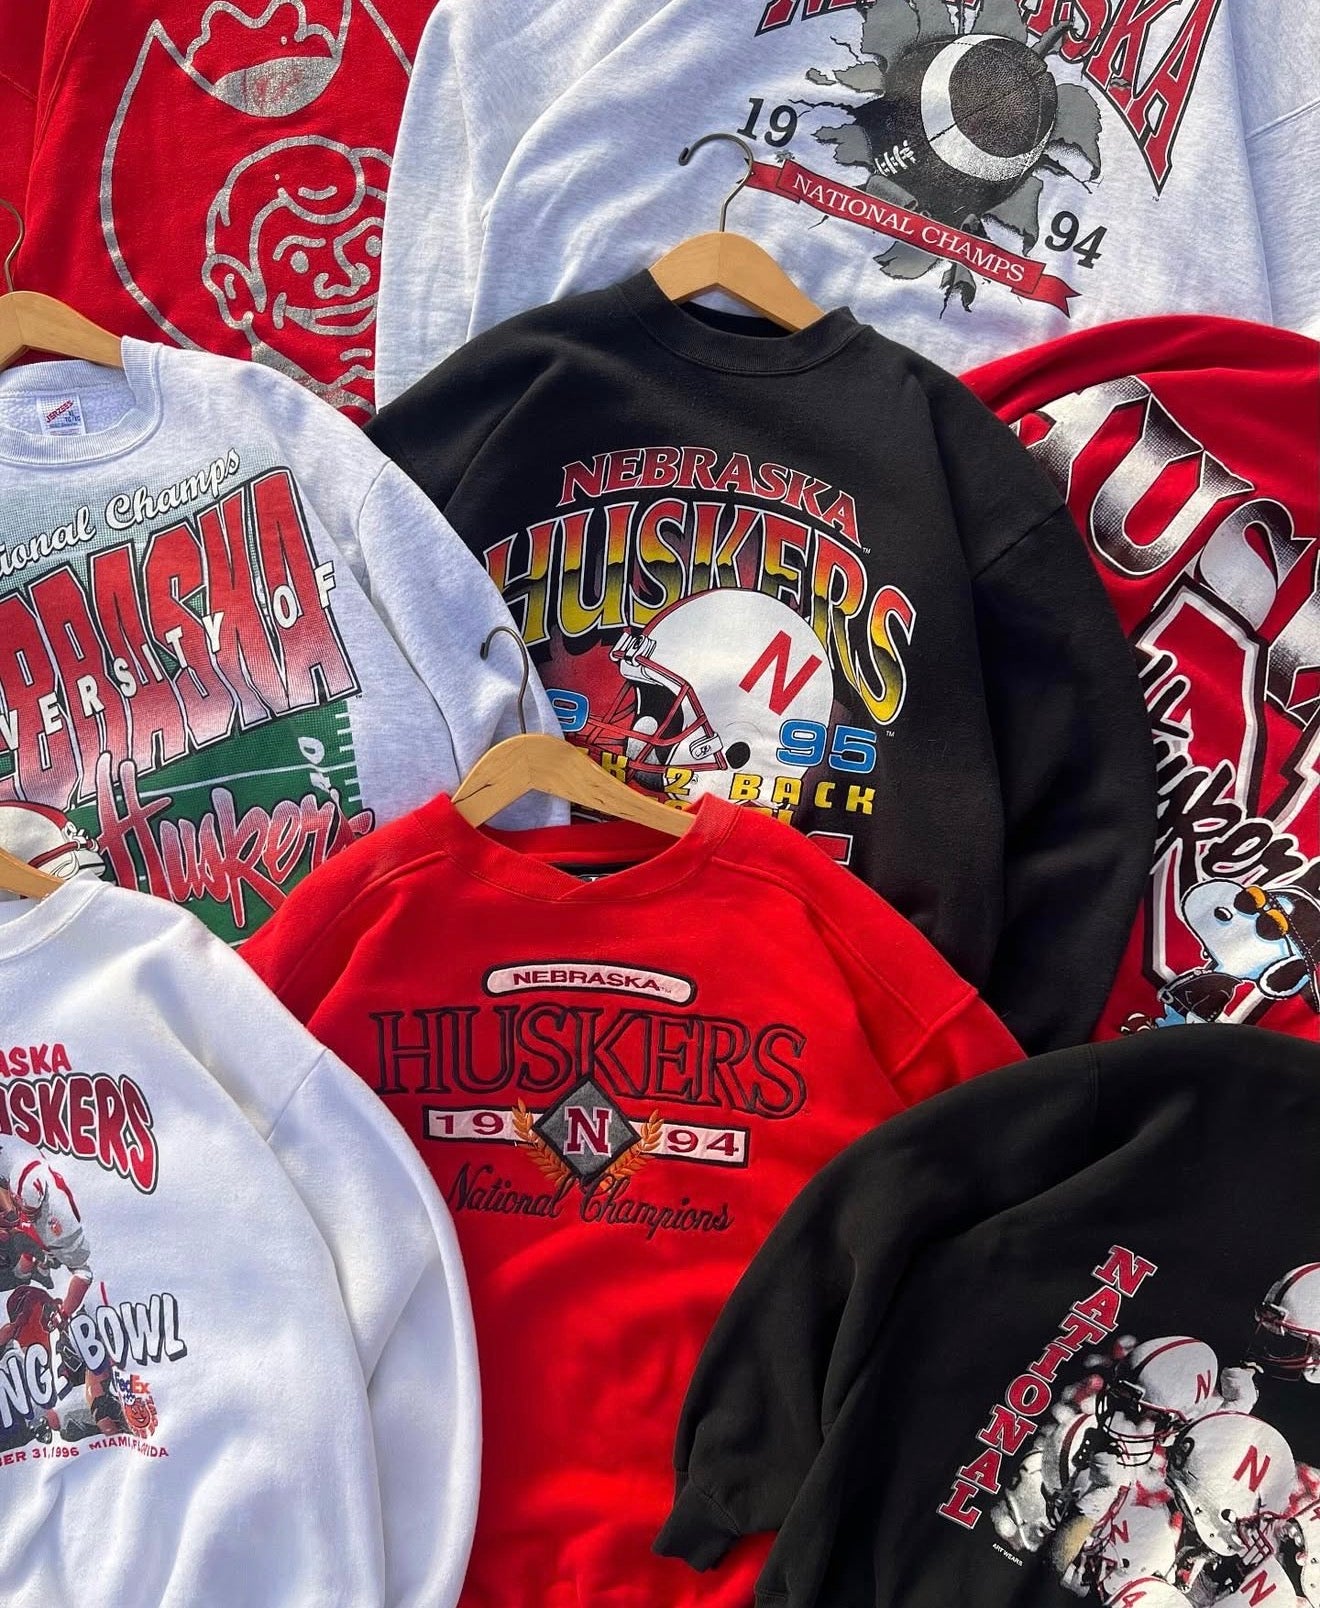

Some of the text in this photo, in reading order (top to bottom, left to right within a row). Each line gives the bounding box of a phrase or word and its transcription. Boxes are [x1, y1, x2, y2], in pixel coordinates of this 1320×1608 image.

[737, 97, 798, 147] 19
[794, 173, 1025, 282] NATIONAL CHAMPS
[1044, 210, 1108, 269] 94
[0, 448, 241, 579] ional Champs
[556, 446, 863, 549] NEBRASKA
[272, 560, 338, 630] OF
[483, 498, 917, 726] HUSKERS
[0, 466, 363, 812] BRASKA
[739, 630, 823, 716] N
[776, 719, 878, 775] 95
[663, 766, 695, 797] 2
[728, 772, 877, 816] BACK
[512, 969, 661, 992] NEBRASKA
[368, 1001, 809, 1121] HUSKERS
[435, 1106, 740, 1158] 19 N 94
[447, 1160, 733, 1240] National Champions
[69, 1292, 188, 1374] BOWL
[114, 1370, 150, 1394] FedEx
[936, 1244, 1158, 1530] NATIONAL
[0, 1451, 27, 1467] ER
[1232, 1445, 1271, 1493] N
[1240, 1569, 1277, 1608] N
